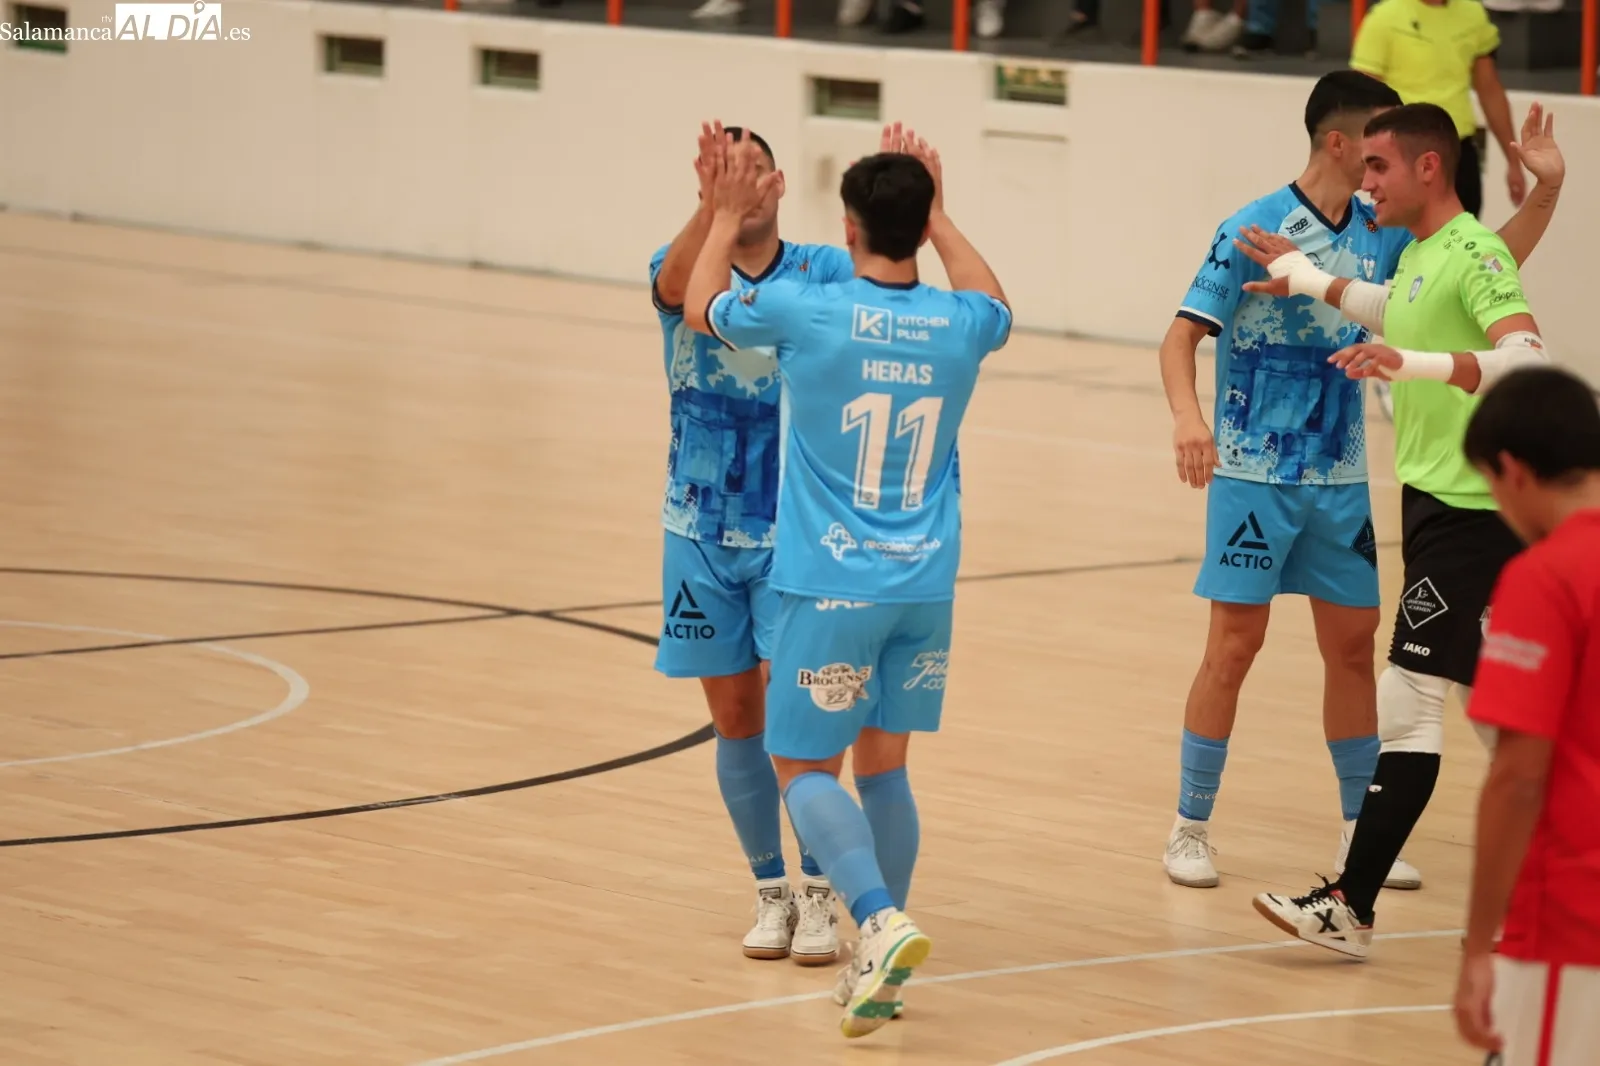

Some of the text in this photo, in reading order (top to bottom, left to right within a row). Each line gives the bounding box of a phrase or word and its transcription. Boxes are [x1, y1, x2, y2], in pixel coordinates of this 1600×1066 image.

[897, 315, 950, 328] KITCHEN
[897, 328, 931, 341] PLUS
[861, 358, 934, 385] HERAS
[840, 391, 945, 511] 11
[1219, 551, 1273, 571] ACTIO
[664, 621, 717, 640] ACTIO
[1402, 641, 1431, 657] JAKO
